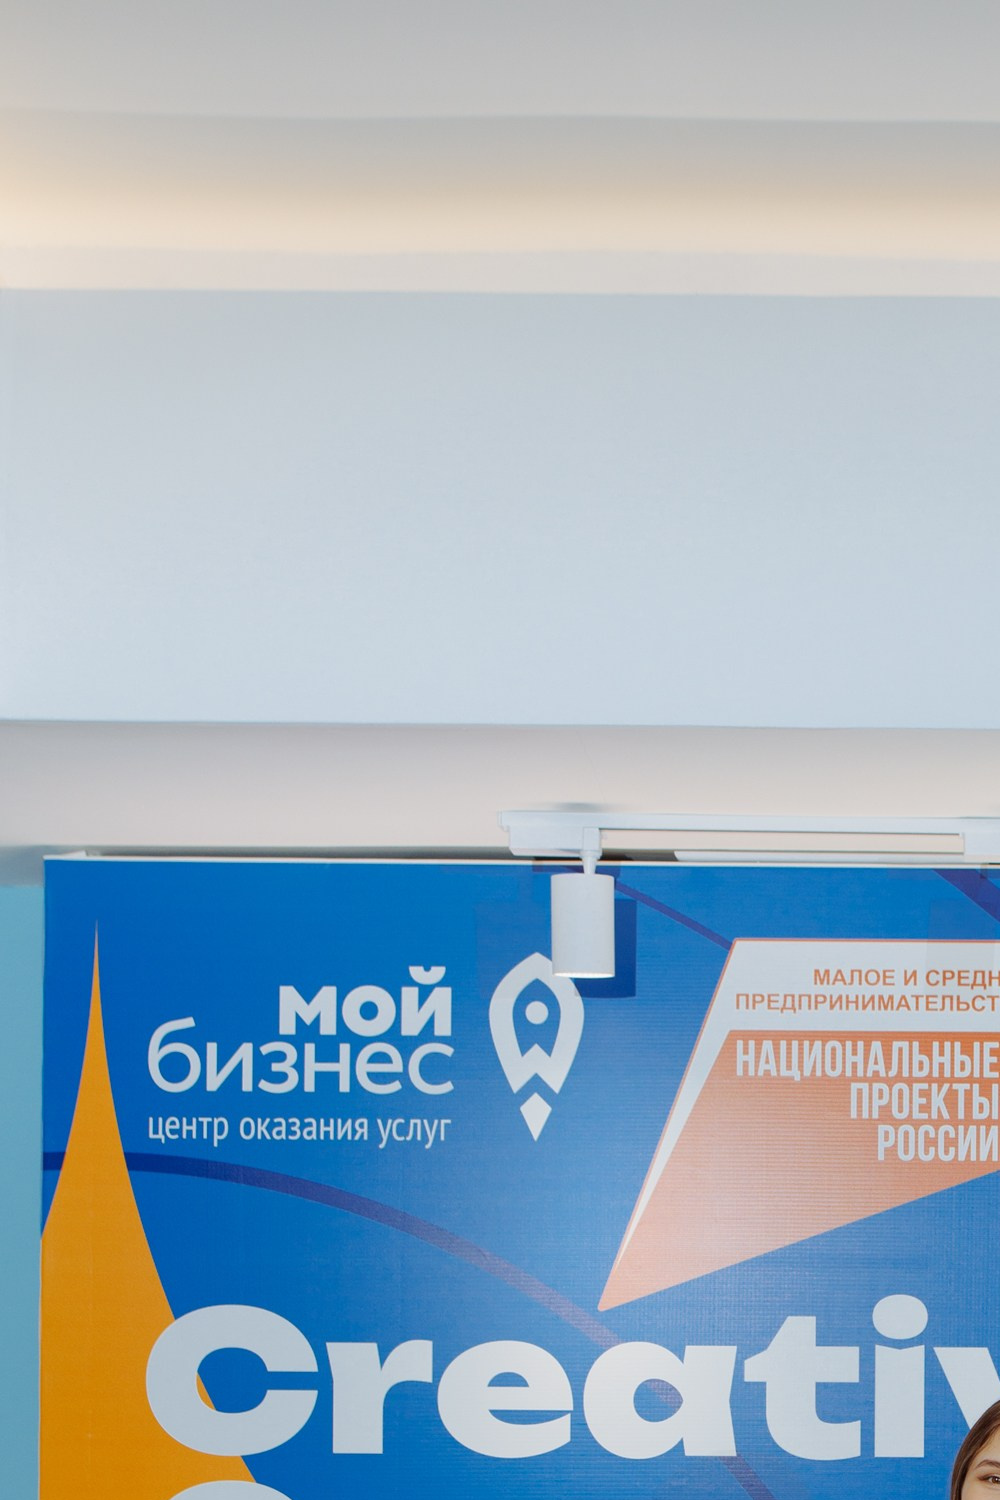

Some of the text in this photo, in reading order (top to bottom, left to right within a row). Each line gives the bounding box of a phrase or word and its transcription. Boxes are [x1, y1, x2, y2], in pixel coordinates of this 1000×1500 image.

[813, 968, 896, 987] МАЛОЕ
[904, 969, 918, 987] И
[279, 966, 453, 1037] мой
[147, 1016, 455, 1095] бизнес
[735, 1039, 1000, 1081] НАЦИОНАЛЬНЫЕ
[850, 1082, 999, 1121] ПРОЕКТЫ
[148, 1115, 452, 1149] центр оказания услуг
[877, 1124, 999, 1162] РОССИИ
